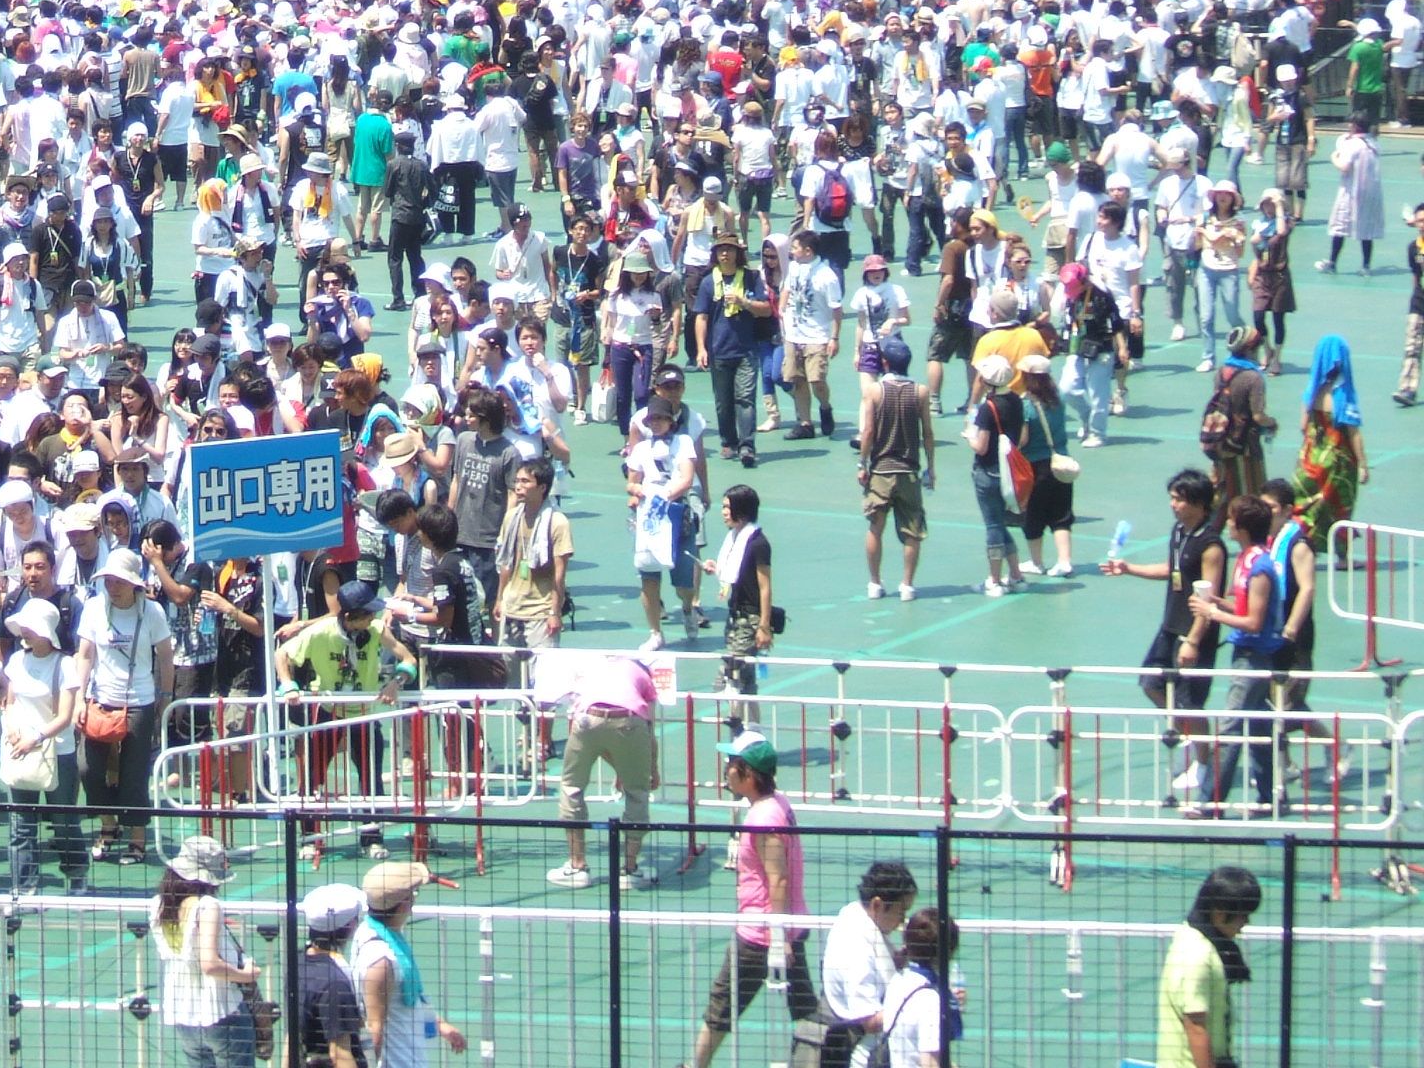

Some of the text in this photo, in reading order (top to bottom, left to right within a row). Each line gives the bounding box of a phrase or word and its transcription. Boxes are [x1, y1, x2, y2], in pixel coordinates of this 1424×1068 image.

[464, 458, 490, 473] CLASS
[198, 456, 336, 526] 出口専用
